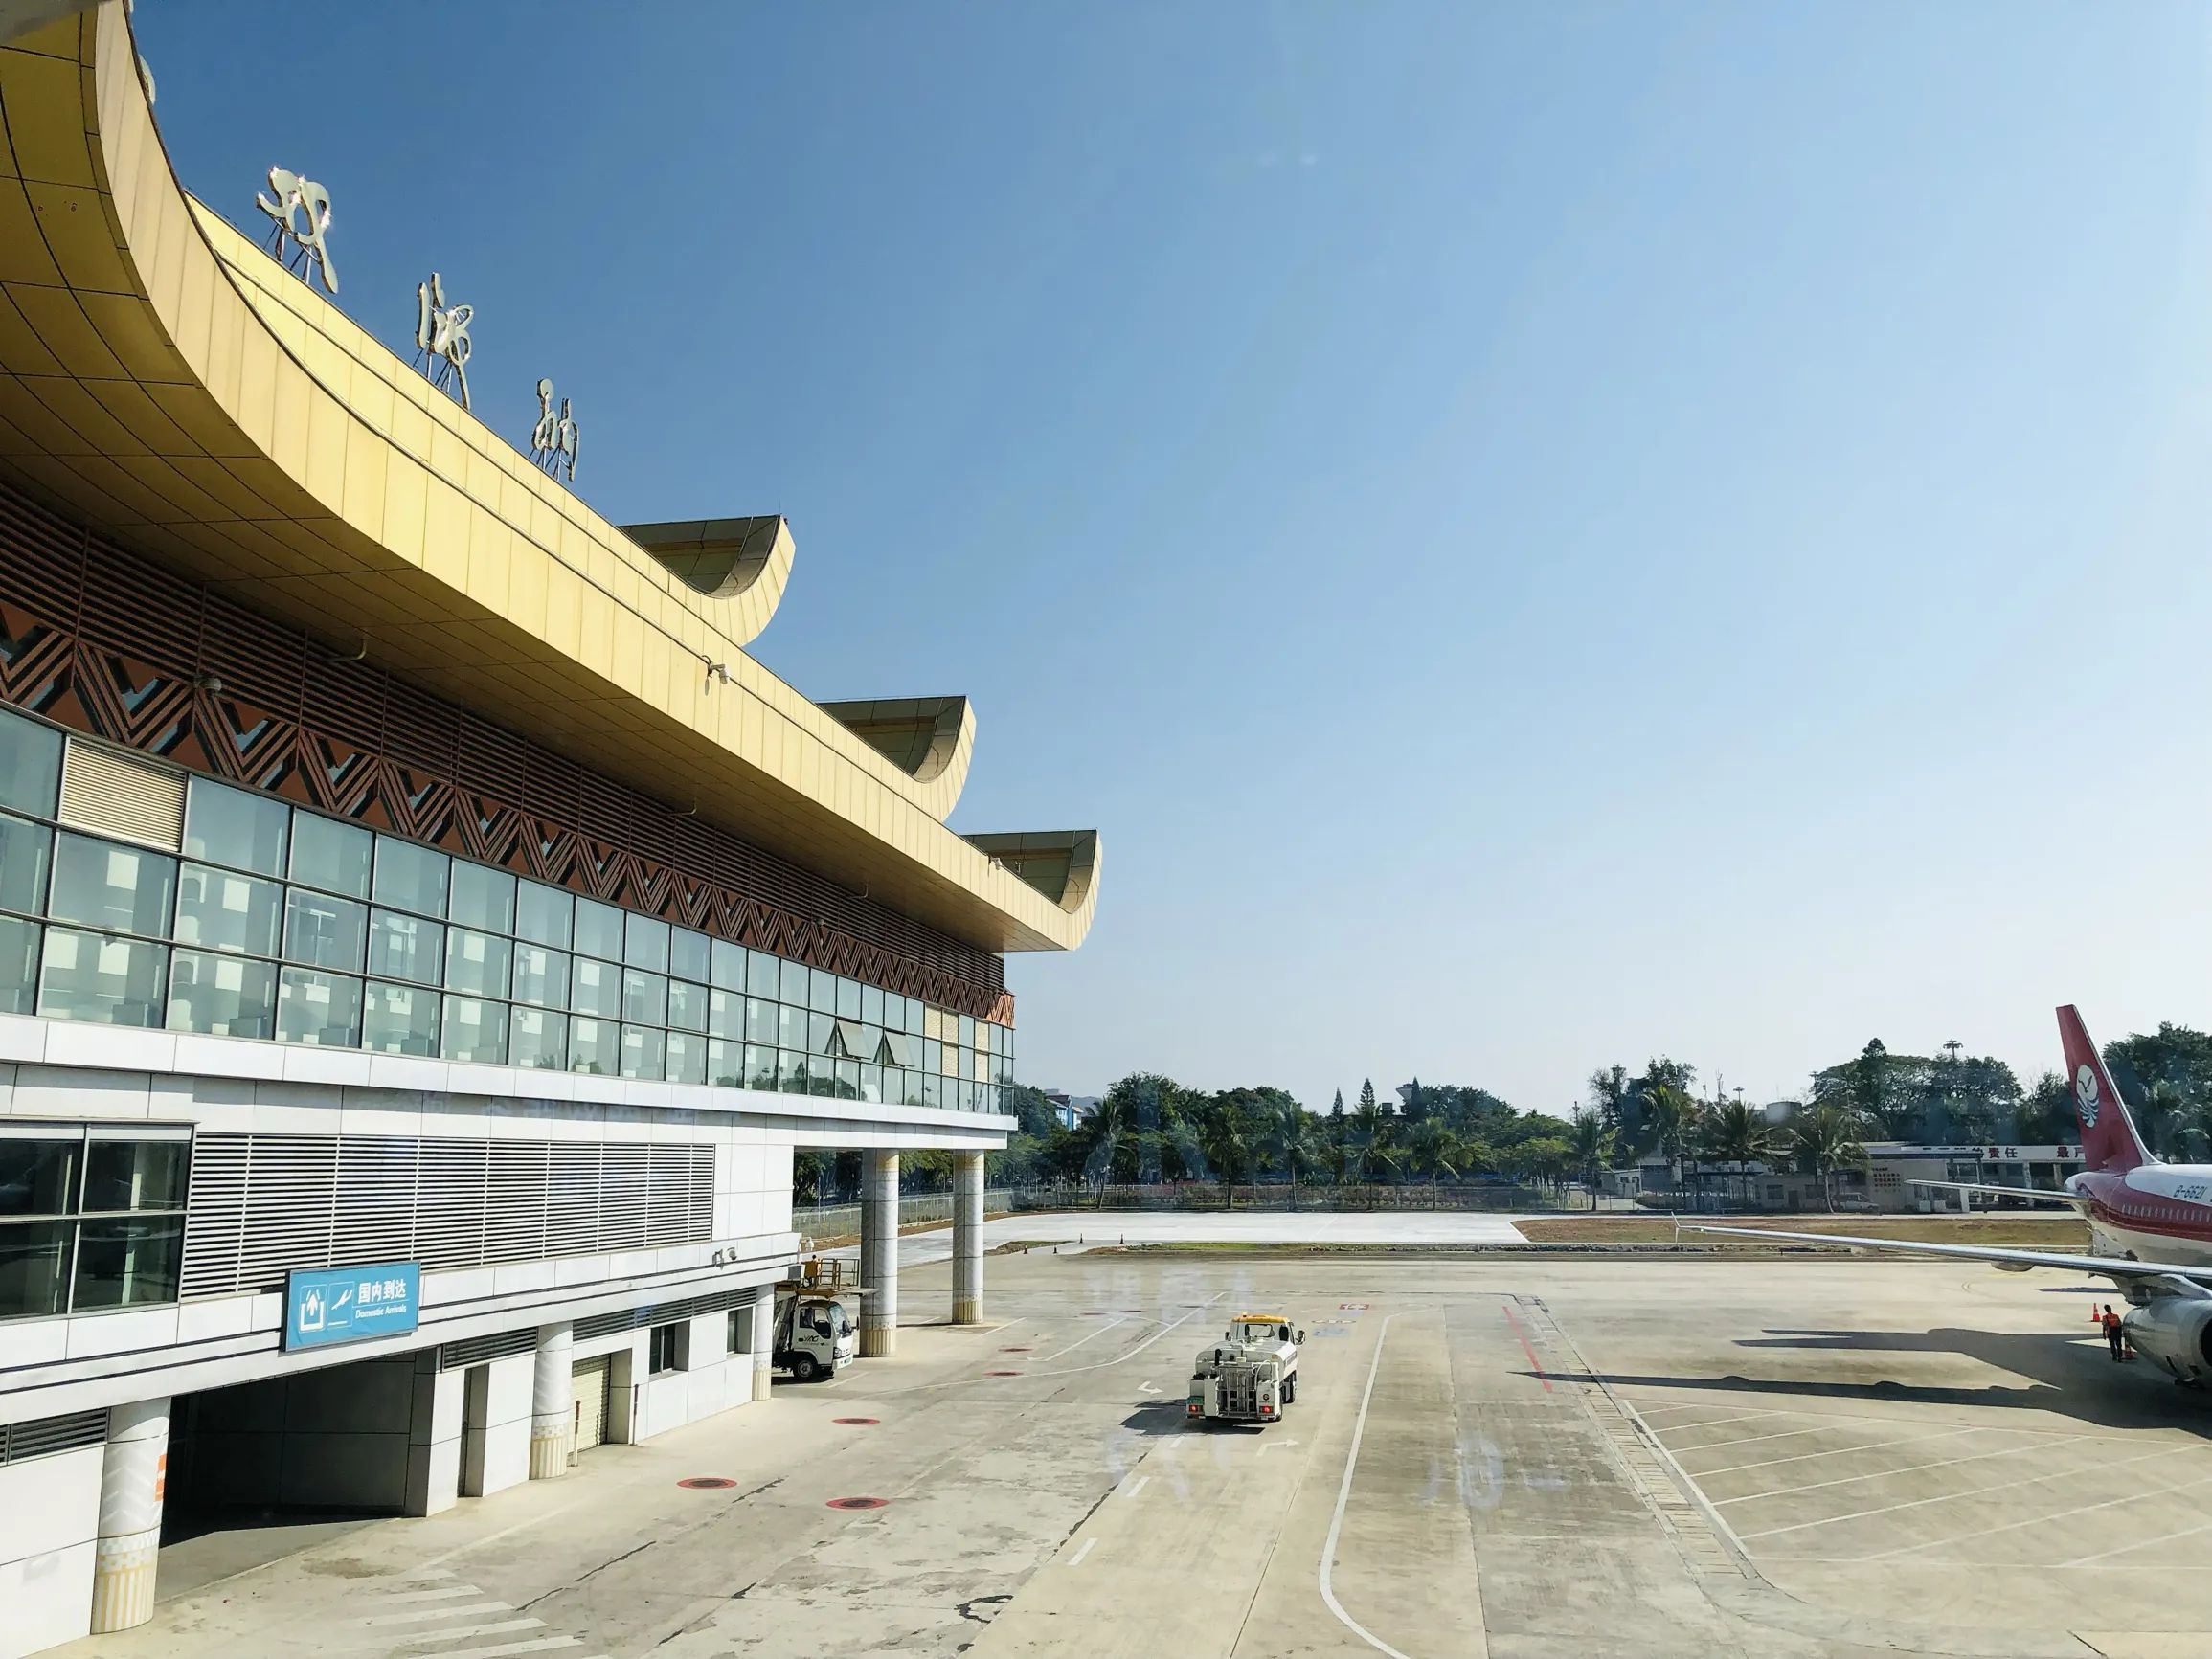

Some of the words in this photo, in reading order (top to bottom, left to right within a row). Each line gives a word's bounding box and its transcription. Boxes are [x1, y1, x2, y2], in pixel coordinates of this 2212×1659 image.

[2173, 1184, 2208, 1199] B-6621
[358, 1279, 407, 1304] 国内到达
[355, 1308, 384, 1319] Domestic
[385, 1304, 407, 1314] Arrivals
